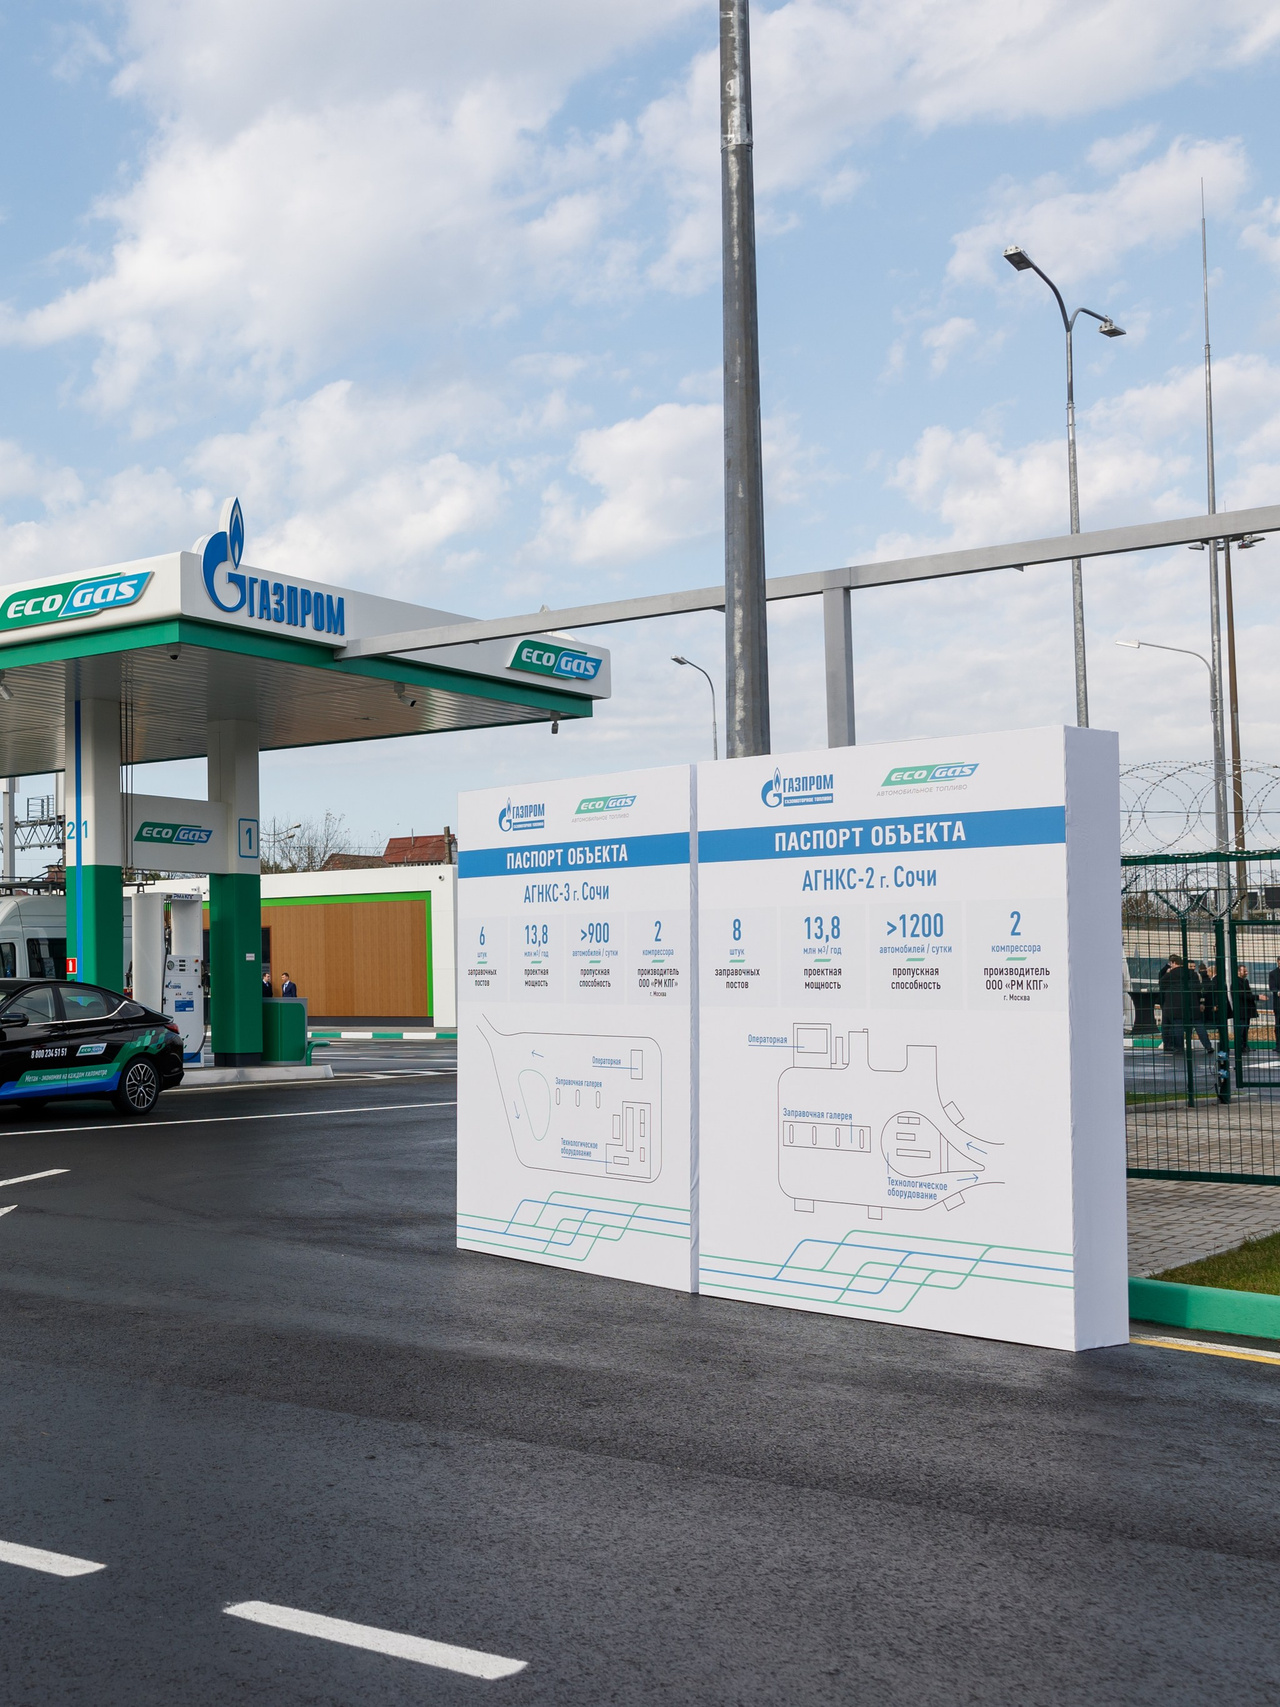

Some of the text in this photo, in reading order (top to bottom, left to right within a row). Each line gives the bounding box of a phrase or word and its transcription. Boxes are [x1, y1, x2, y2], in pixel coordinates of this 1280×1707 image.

[7, 594, 63, 619] ECO
[248, 577, 345, 636] ГАЗПРОМ
[522, 648, 556, 666] ECO
[890, 770, 927, 781] ECO
[783, 774, 833, 793] ГАЗПРОМ
[877, 784, 968, 797] АВТОМОБИЛЬНОЕ ТОПЛИВО
[513, 803, 544, 819] ГАЗПРОМ
[581, 801, 604, 810] ECO
[67, 822, 75, 839] 2
[82, 820, 88, 838] 1
[142, 827, 173, 838] ECO
[245, 828, 252, 850] 1
[775, 821, 966, 852] ПАСПОРТ ОБЪЕКТА
[507, 844, 628, 870] ПАСПОРТ ОБЪЕКТА
[802, 865, 937, 891] АГНКС-2 г. Сочи
[524, 882, 609, 903] АГНКС-3 г. Сочи
[886, 913, 944, 938] >1200
[1010, 911, 1021, 936] 2
[580, 922, 609, 943] >900
[654, 920, 662, 942] 2
[733, 919, 742, 941] 8
[804, 916, 840, 943] 13,8
[480, 926, 485, 945] 6
[525, 924, 548, 947] 13,8
[642, 948, 674, 956] компрессора
[730, 949, 745, 957] штук
[830, 947, 842, 955] год
[879, 944, 925, 954] автомобилей
[931, 946, 952, 955] сутки
[991, 944, 1041, 954] компрессора
[524, 969, 549, 977] проектная
[580, 969, 610, 977] пропускная
[637, 968, 679, 977] производитель
[715, 968, 760, 978] заправочных
[804, 968, 842, 978] проектная
[892, 967, 939, 977] пропускная
[984, 966, 1050, 977] производитель
[579, 979, 611, 987] способность
[639, 979, 650, 987] ООО
[804, 981, 841, 990] мощность
[891, 980, 941, 990] способность
[986, 980, 1003, 990] ООО
[748, 1034, 787, 1044] Операторная
[35, 1050, 44, 1058] 800
[592, 1056, 621, 1065] Операторная
[555, 1077, 583, 1086] Заправочная
[783, 1108, 852, 1121] Заправочная галерея
[561, 1138, 598, 1149] Технологическое
[561, 1147, 591, 1157] оборудование
[887, 1177, 948, 1191] Технологическое
[887, 1188, 937, 1200] оборудование
